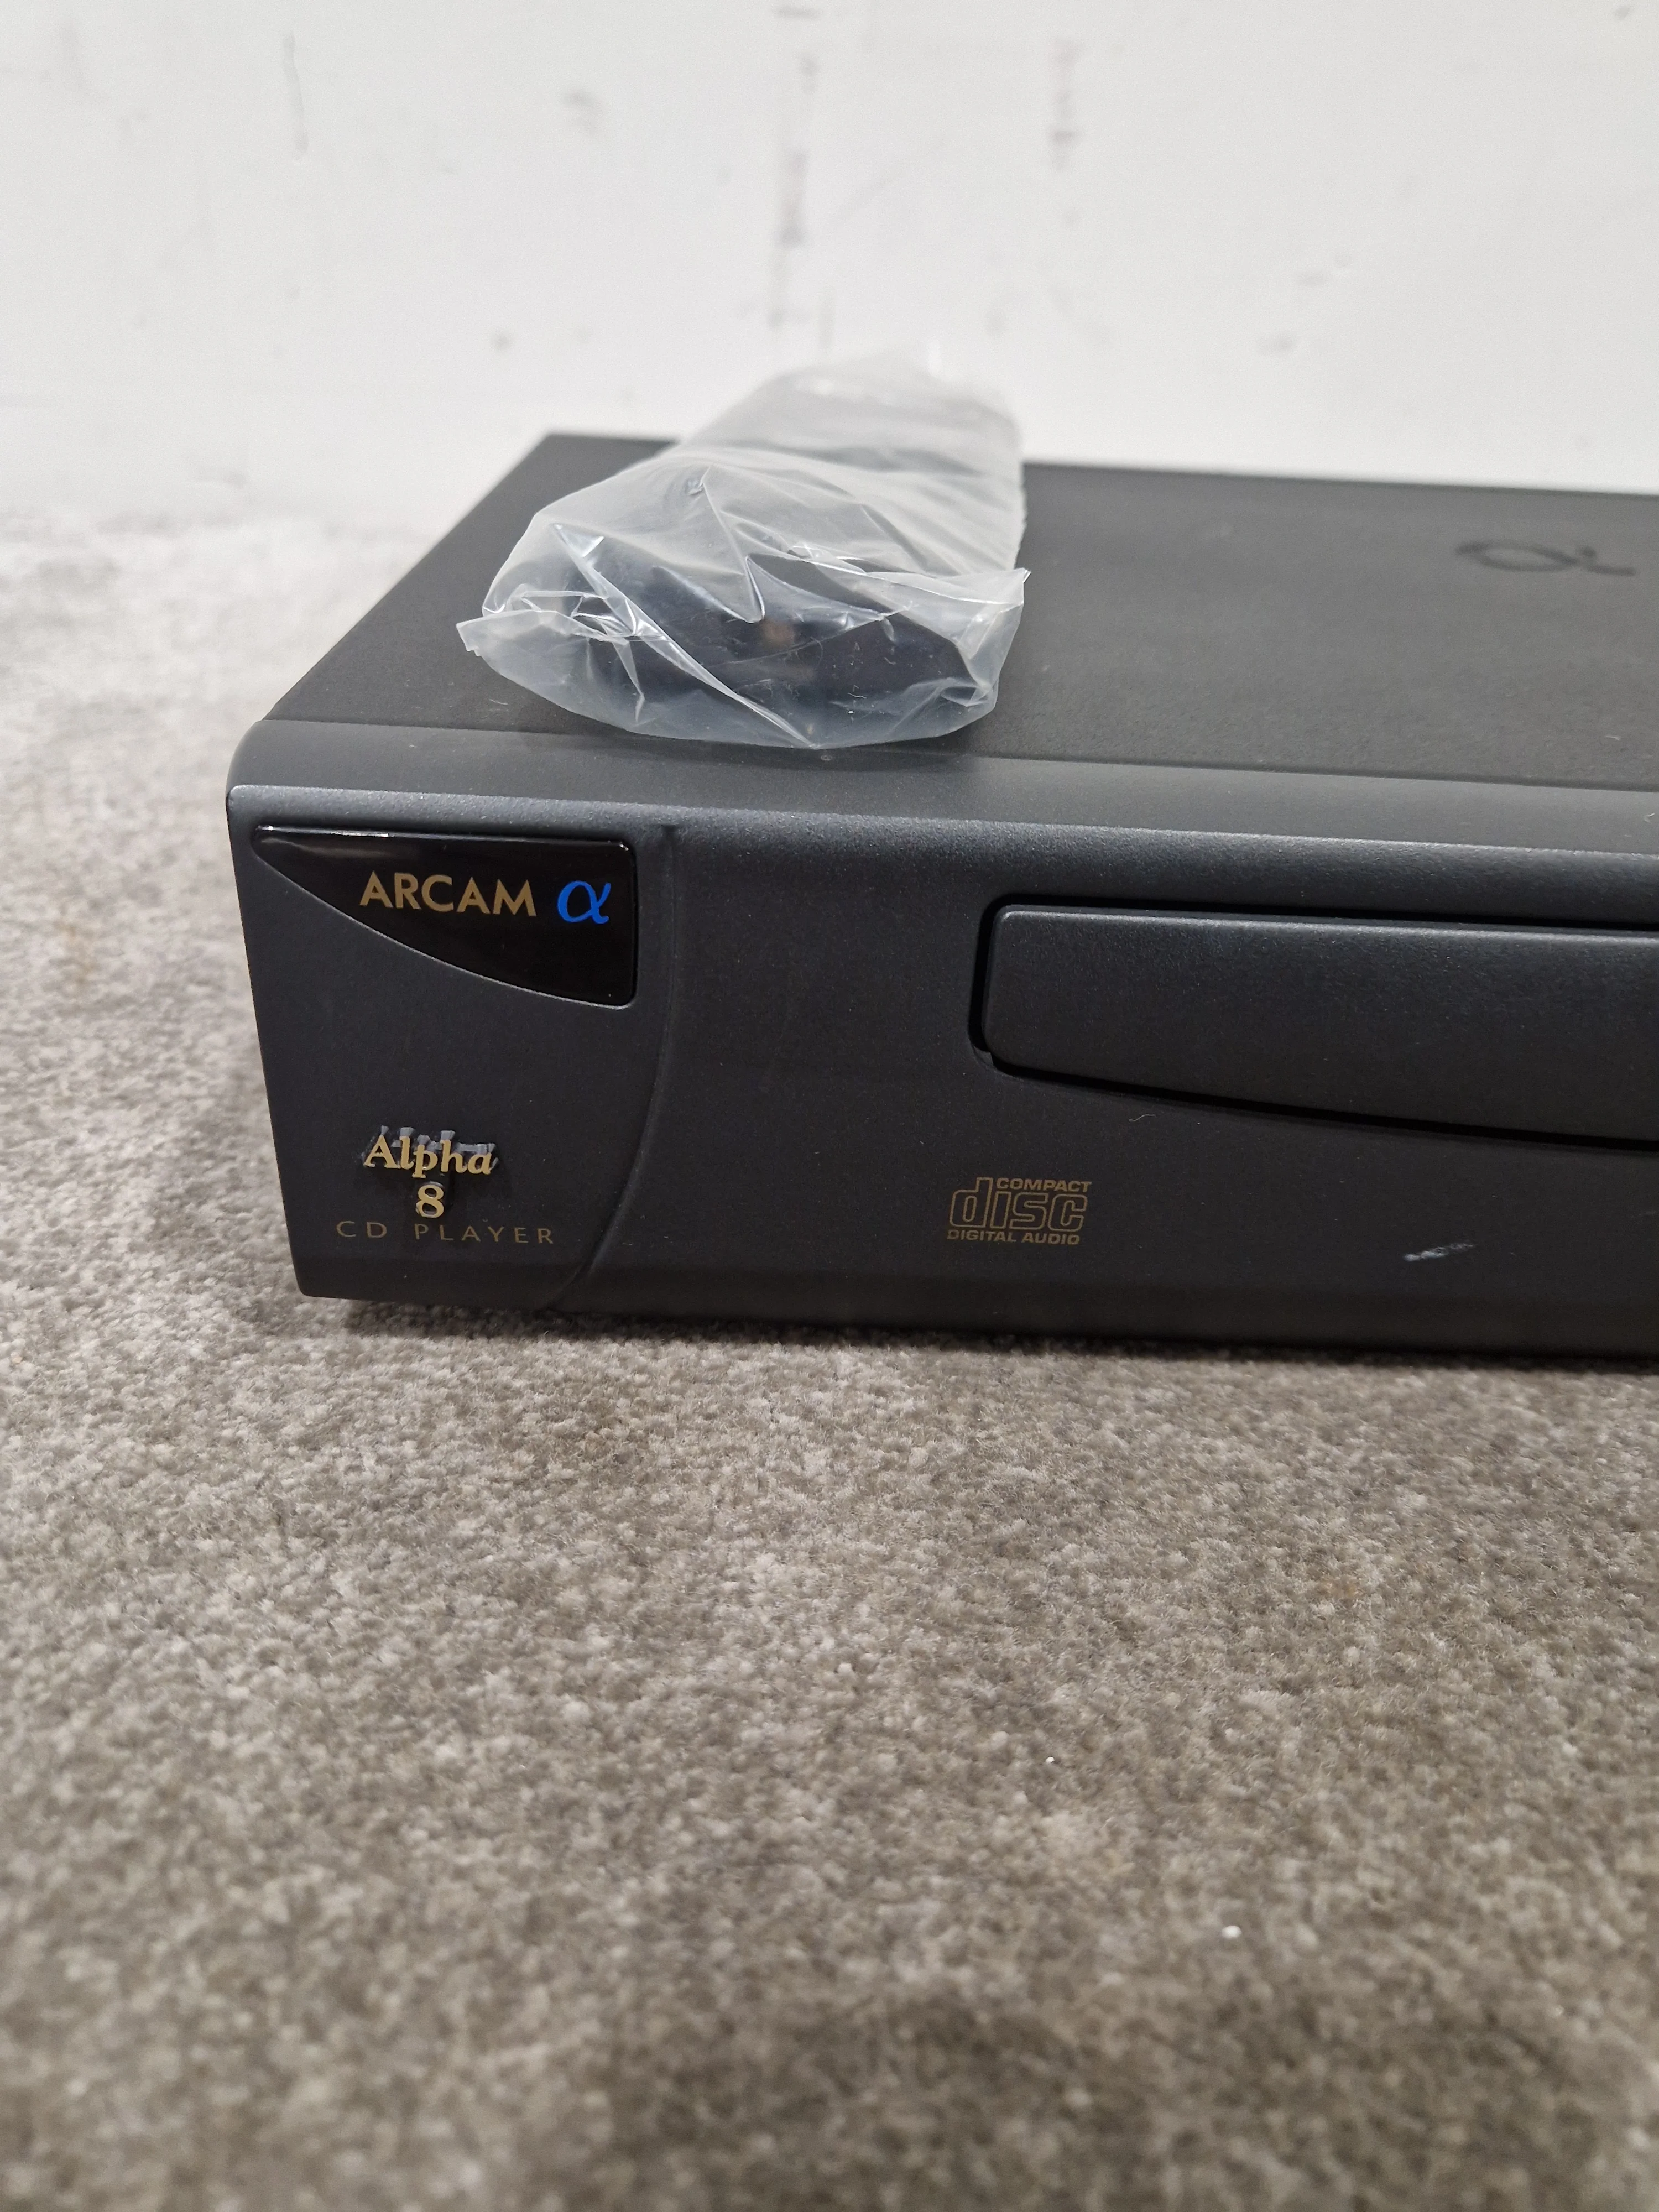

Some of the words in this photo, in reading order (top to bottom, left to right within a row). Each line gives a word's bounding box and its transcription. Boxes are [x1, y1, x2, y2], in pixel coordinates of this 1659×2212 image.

[359, 870, 536, 918] ARCAM
[363, 1125, 499, 1178] Alpha
[415, 1181, 445, 1218] 8
[996, 1177, 1093, 1193] COMPACT
[336, 1220, 387, 1238] CD
[414, 1223, 554, 1244] PLAYER
[946, 1229, 1018, 1243] DIGITAL
[1021, 1232, 1081, 1245] AUDIO
